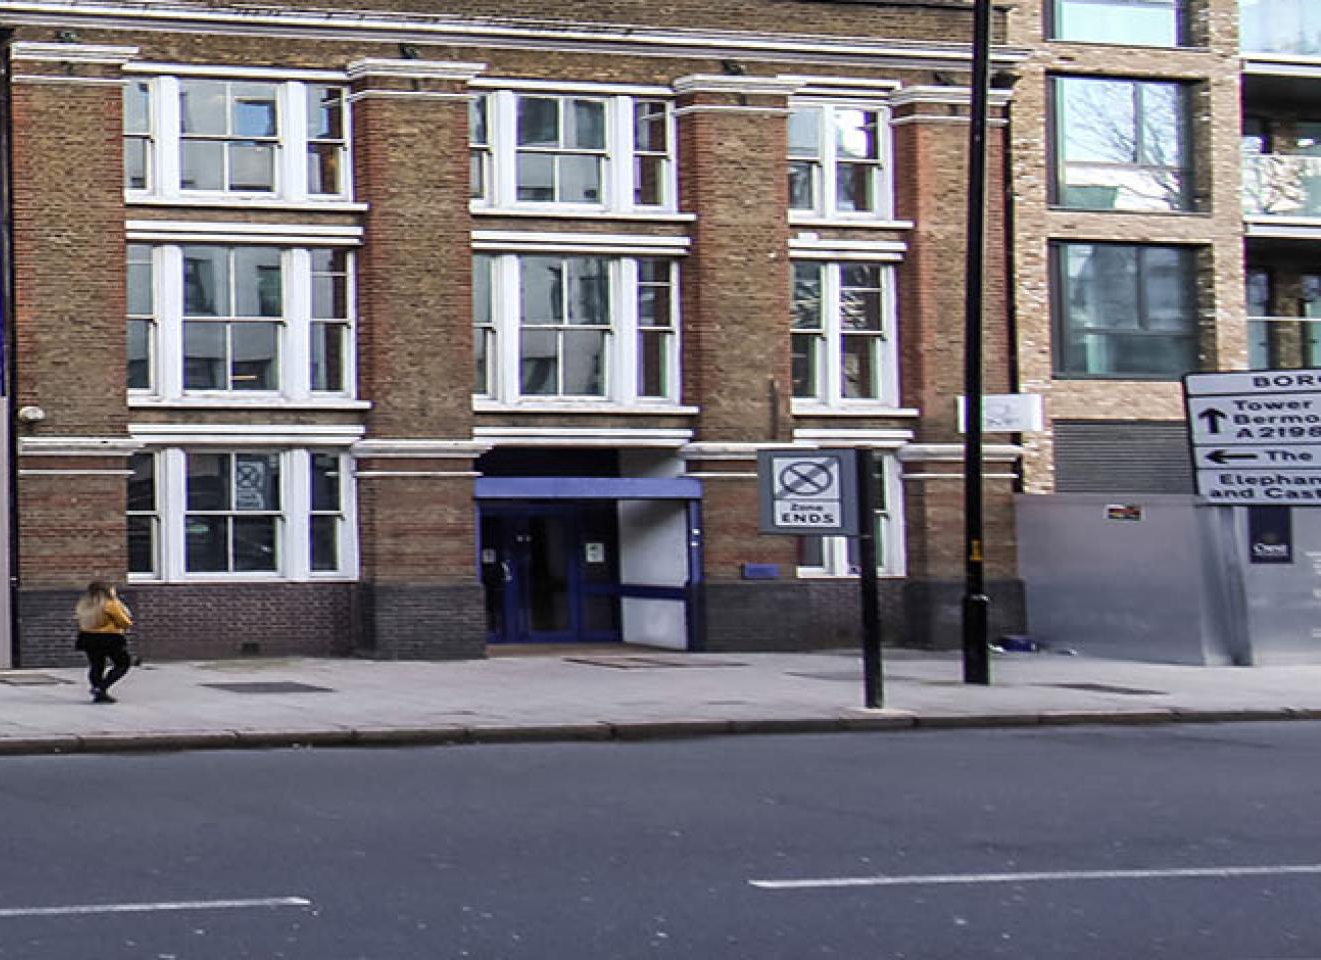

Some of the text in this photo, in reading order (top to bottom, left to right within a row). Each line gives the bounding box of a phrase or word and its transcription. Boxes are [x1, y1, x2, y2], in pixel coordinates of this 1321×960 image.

[1253, 375, 1321, 387] BOR
[1232, 399, 1313, 411] Tower
[1233, 414, 1321, 424] Bermo
[1264, 450, 1313, 462] The
[1210, 487, 1254, 499] and
[791, 502, 823, 511] Zone
[781, 513, 834, 524] ENDS
